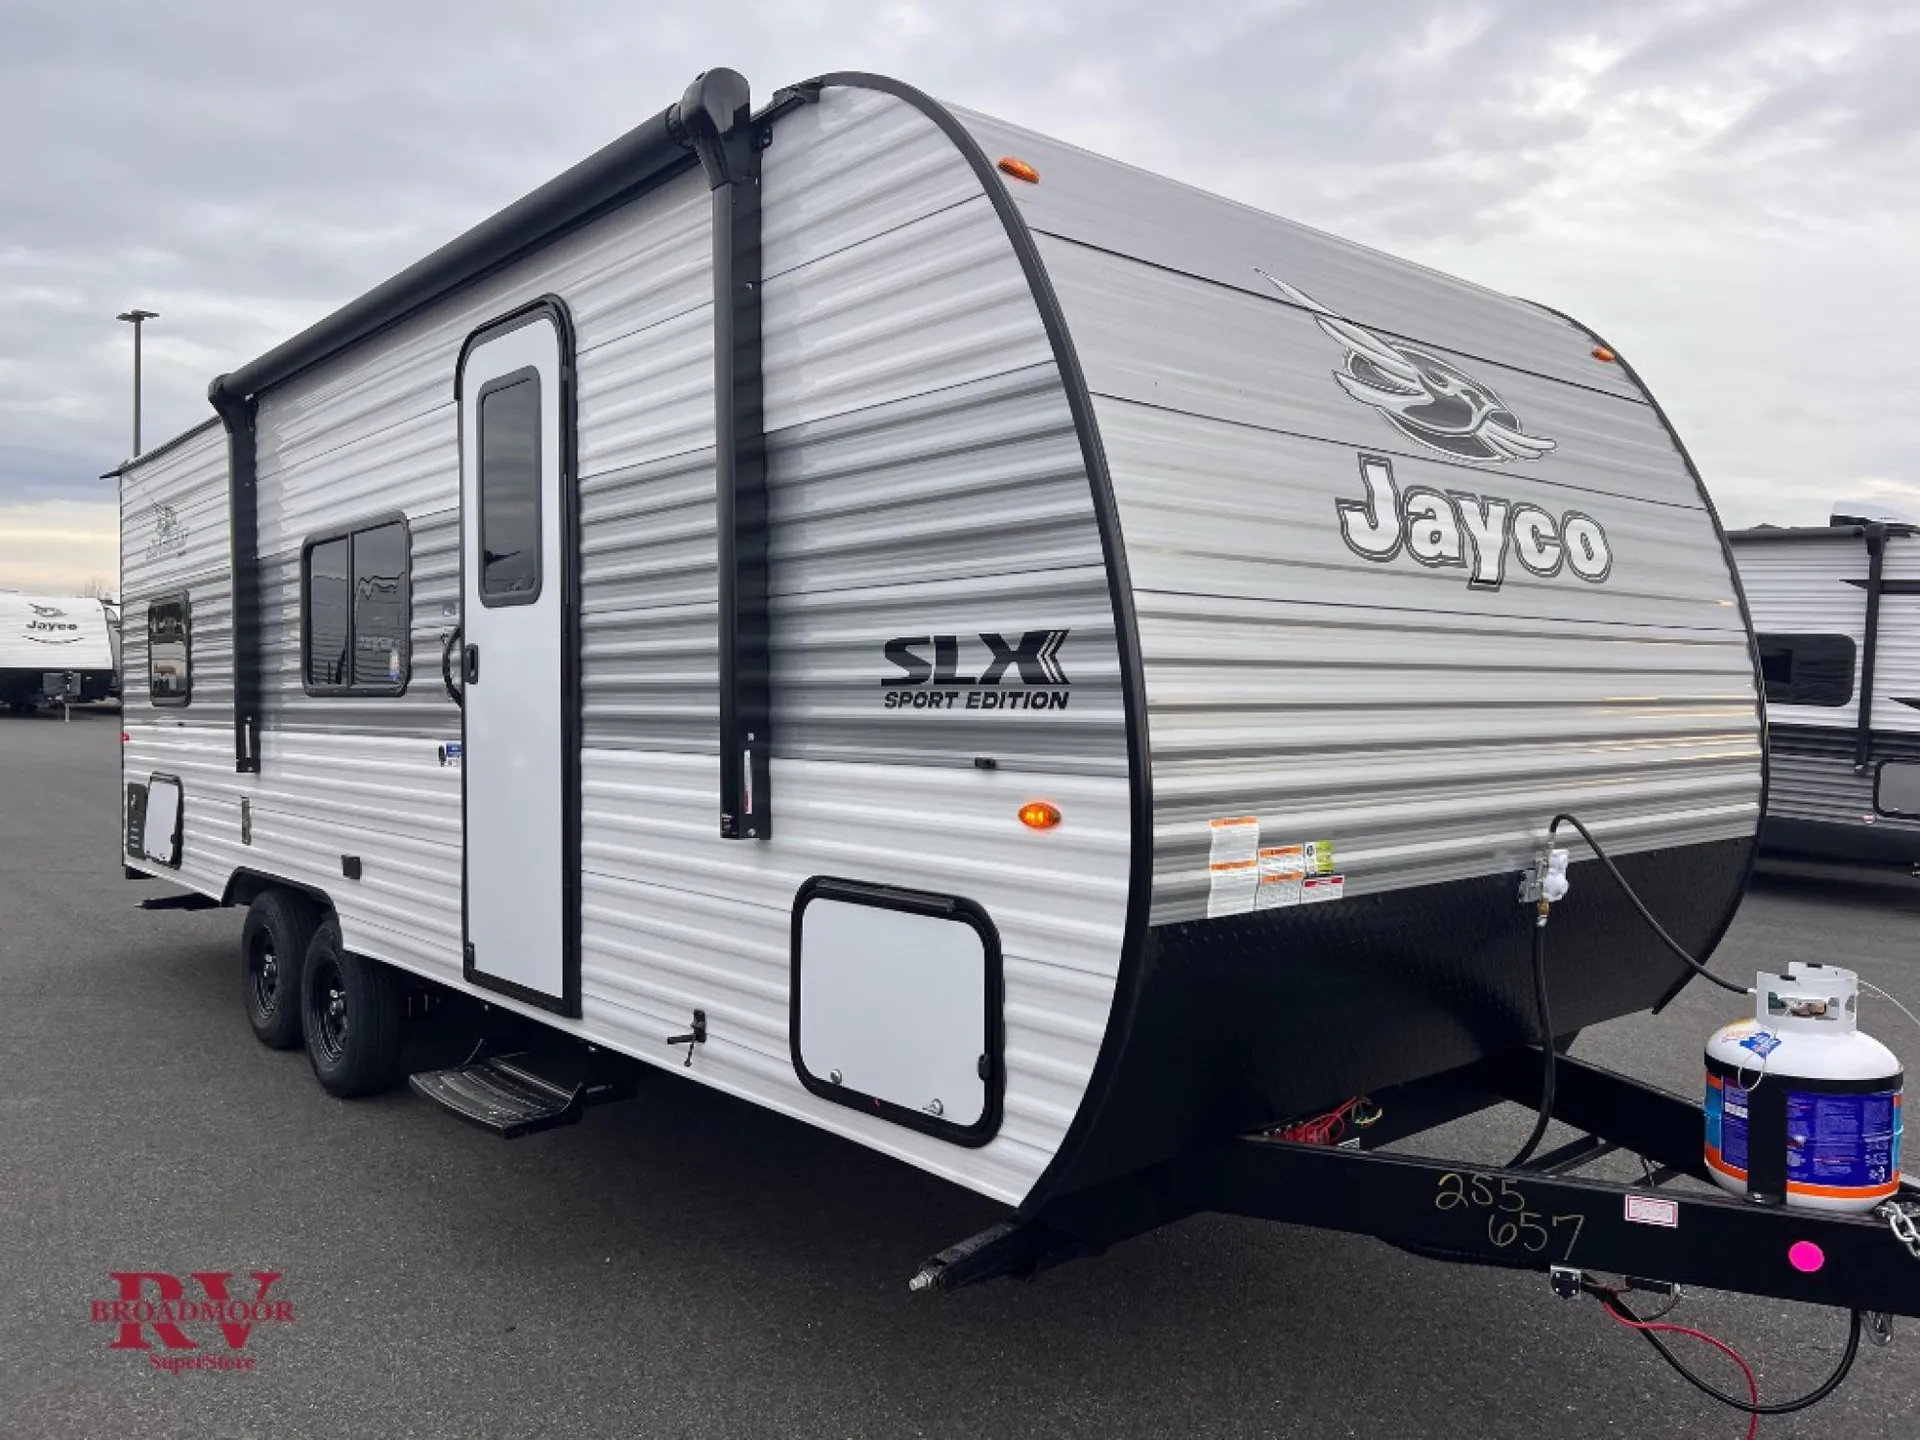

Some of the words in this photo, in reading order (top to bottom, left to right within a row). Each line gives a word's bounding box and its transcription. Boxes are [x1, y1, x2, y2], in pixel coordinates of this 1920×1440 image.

[1335, 452, 1613, 592] Jayco
[26, 620, 78, 631] Jayco
[881, 630, 1071, 686] SLX
[884, 691, 958, 709] SPORT
[965, 691, 1070, 709] EDITION
[1488, 1212, 1585, 1261] 657
